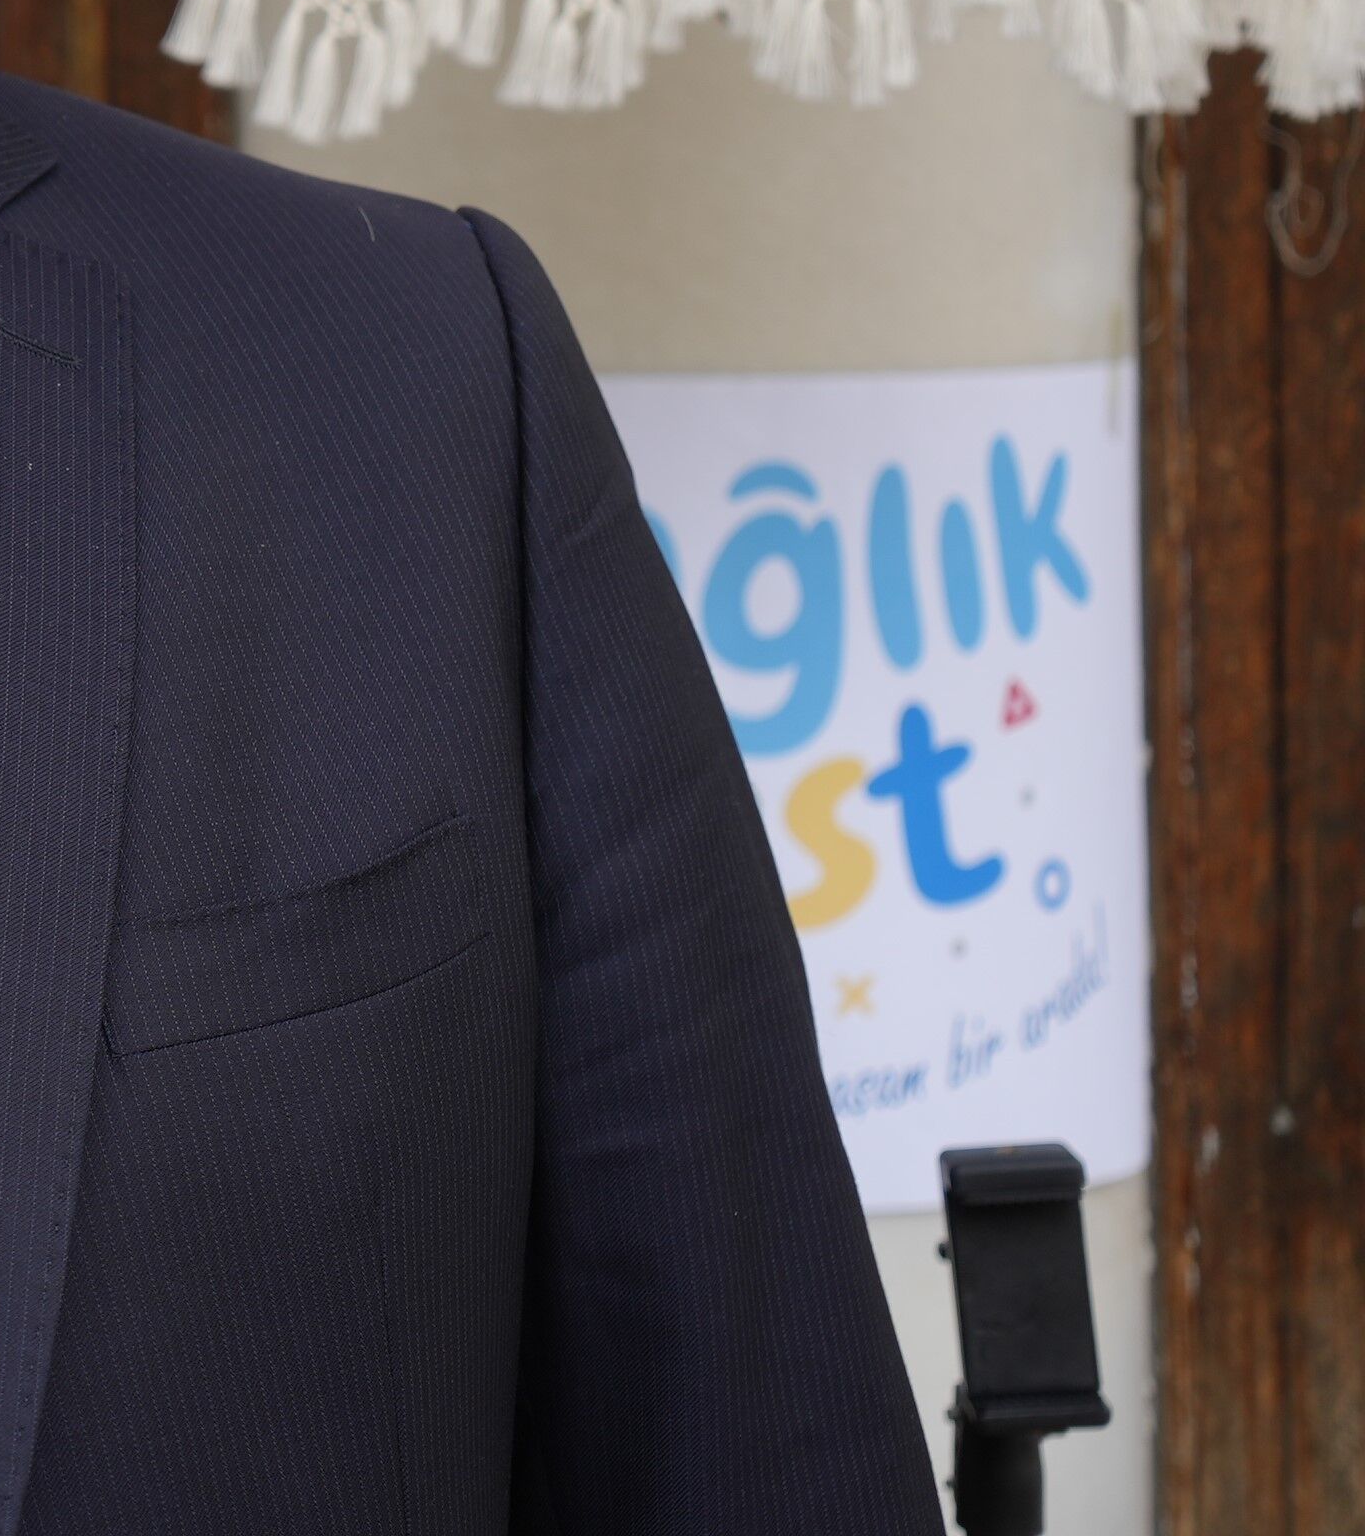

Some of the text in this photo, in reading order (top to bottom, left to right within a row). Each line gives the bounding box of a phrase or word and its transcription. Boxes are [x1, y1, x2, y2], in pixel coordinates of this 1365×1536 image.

[644, 432, 1091, 757] ğlık
[781, 702, 1006, 931] st
[946, 1012, 1005, 1091] bir
